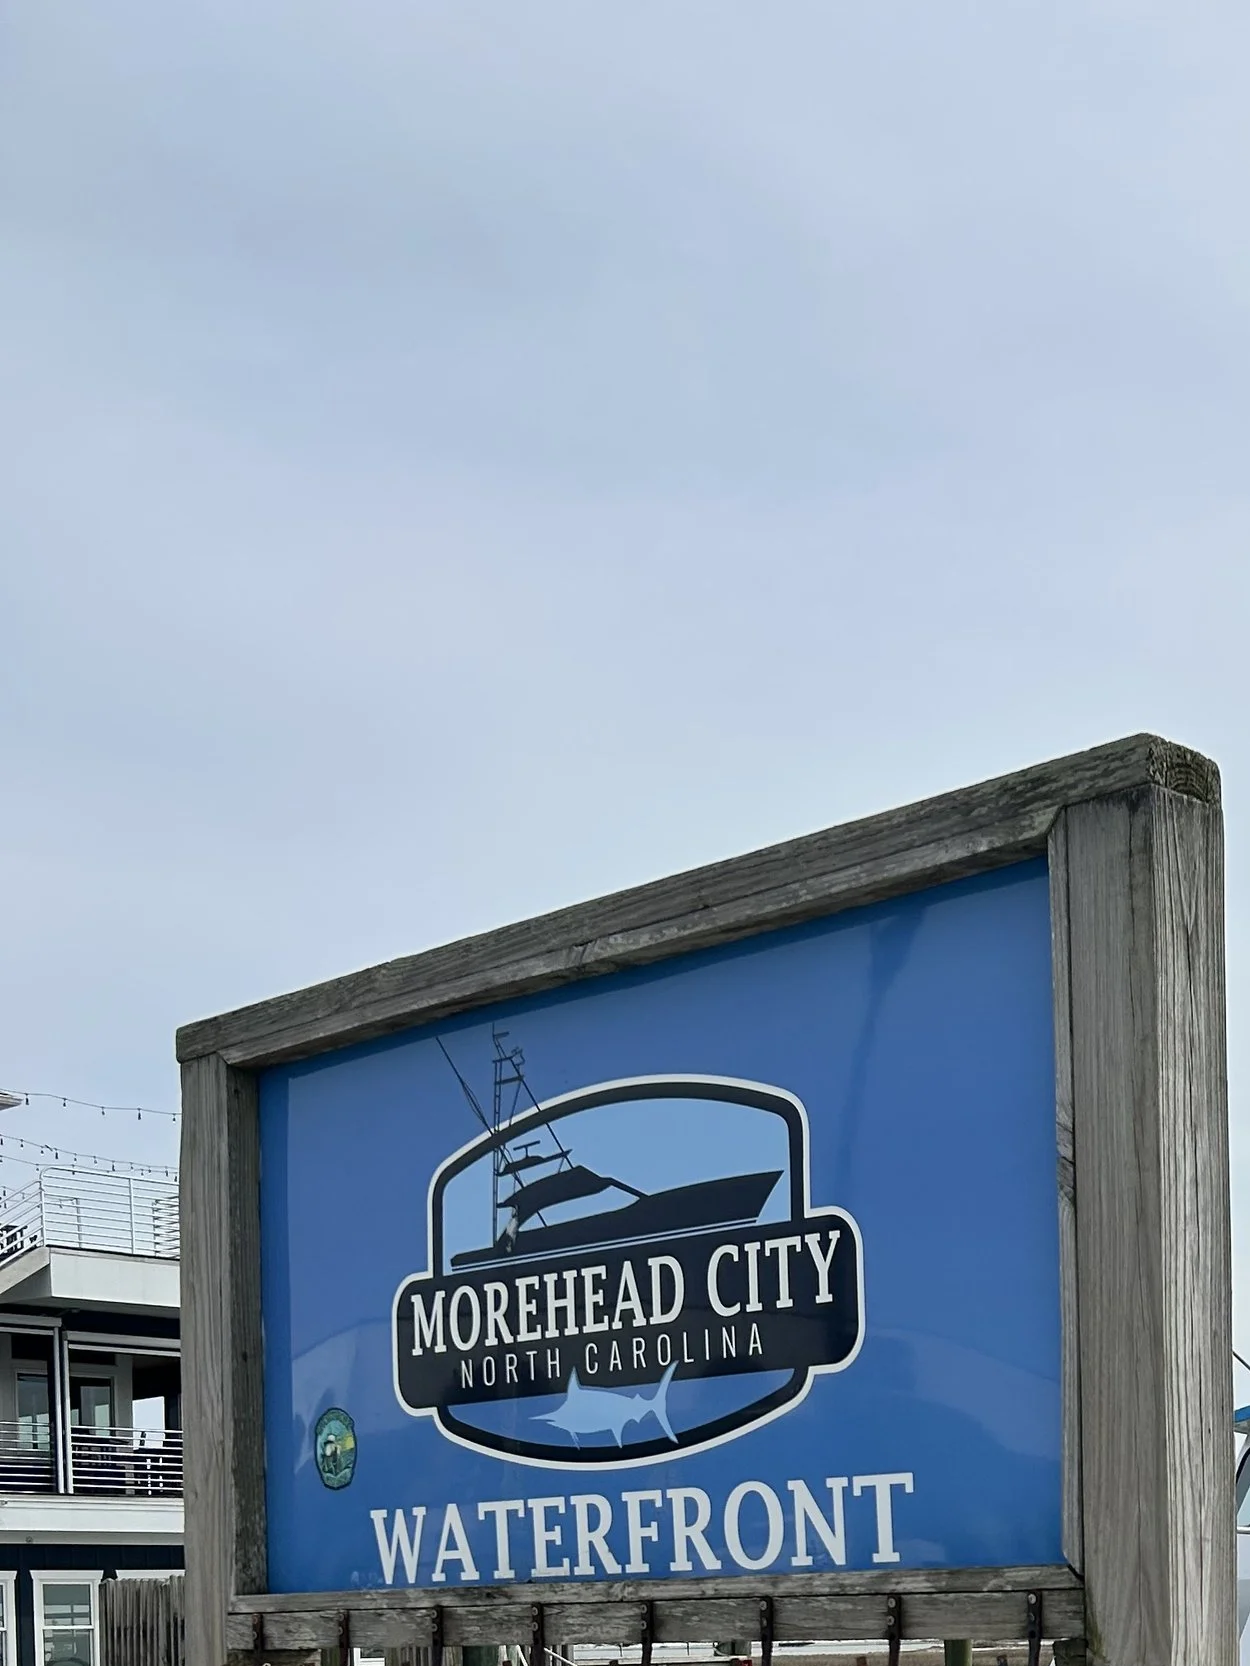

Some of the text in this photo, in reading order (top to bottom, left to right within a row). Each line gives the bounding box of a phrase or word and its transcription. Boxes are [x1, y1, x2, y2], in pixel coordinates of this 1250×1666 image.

[411, 1230, 840, 1356] MOREHEAD CITY
[461, 1322, 764, 1389] NORTH CAROLINA
[370, 1472, 914, 1585] WATERFRONT
